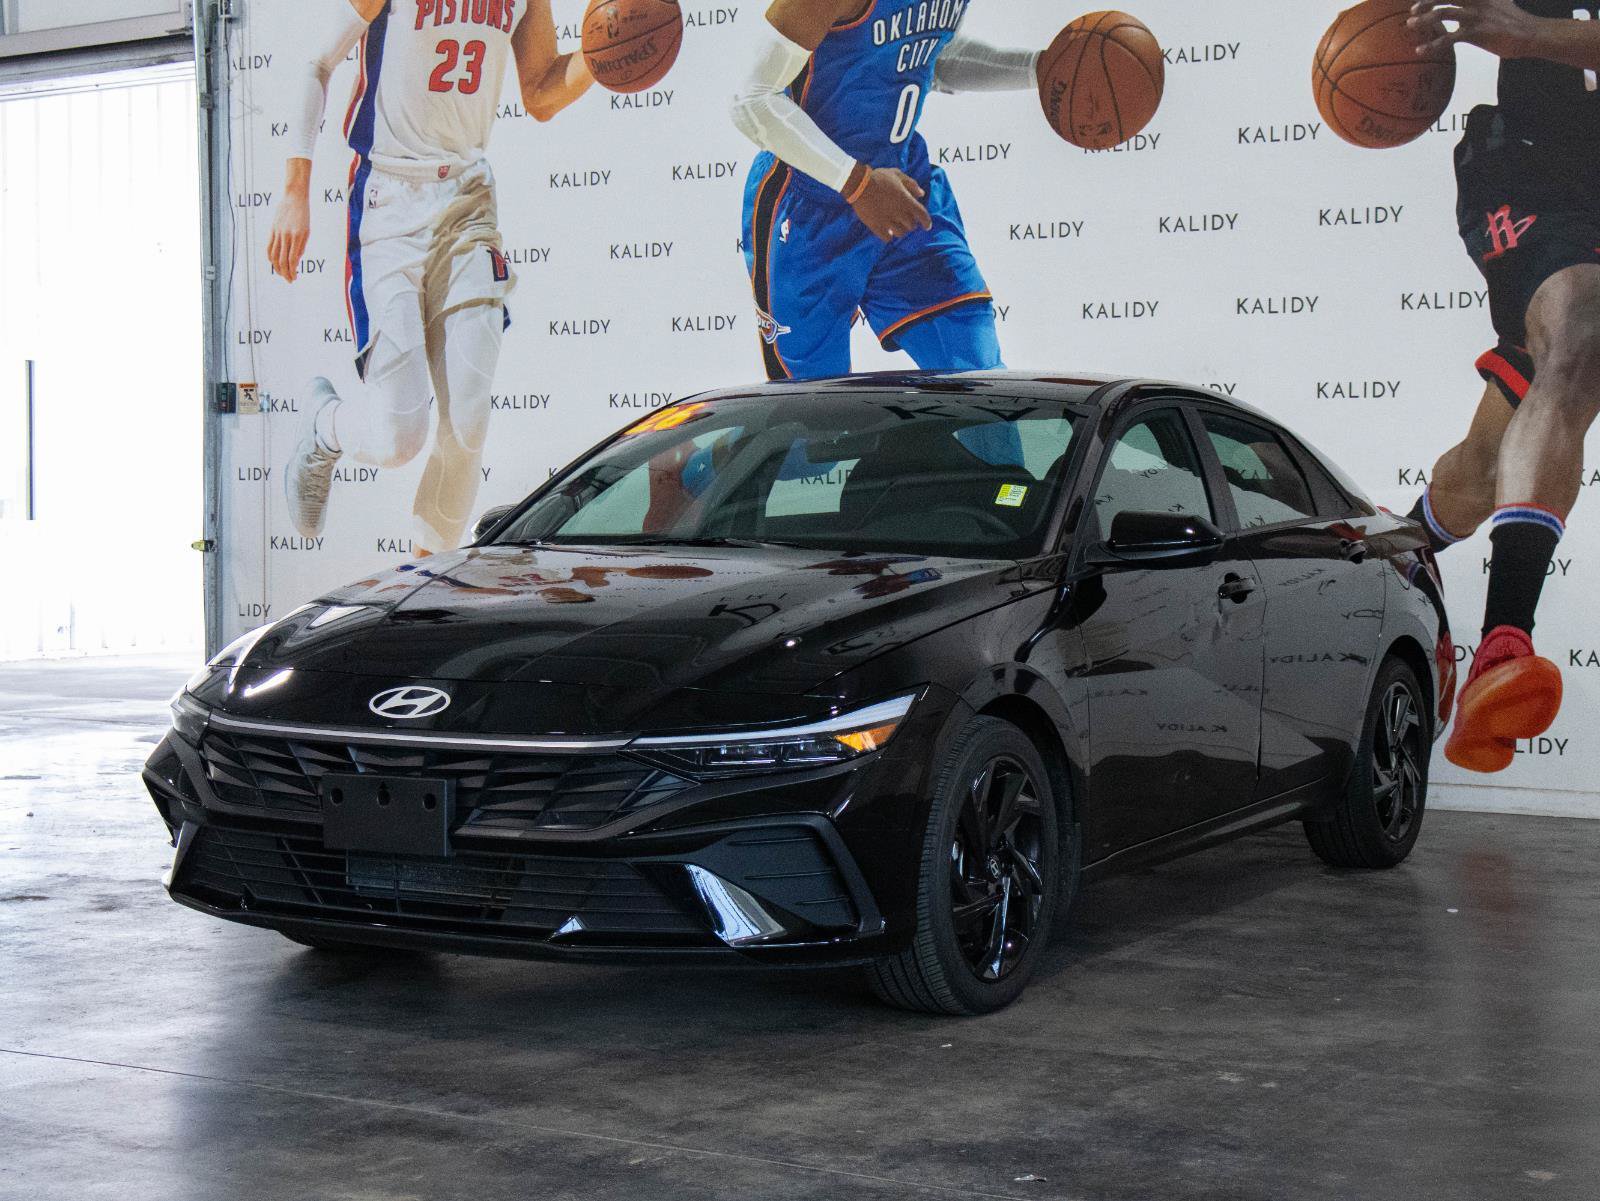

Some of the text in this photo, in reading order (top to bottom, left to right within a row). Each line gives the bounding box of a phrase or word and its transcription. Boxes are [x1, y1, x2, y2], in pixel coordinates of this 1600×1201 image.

[685, 8, 738, 27] ALIDY
[873, 0, 966, 46] OKLAHOM
[232, 54, 272, 71] LIDY
[897, 38, 940, 72] CITY
[1162, 42, 1241, 65] KALIDY
[428, 39, 487, 94] 23
[611, 90, 674, 109] KALIDY
[889, 83, 920, 144] 0
[1238, 123, 1321, 144] KALIDY
[939, 143, 1011, 163] KALIDY
[550, 170, 611, 188] KALIDY
[672, 161, 737, 181] KALIDY
[238, 192, 272, 208] LIDY
[1159, 213, 1238, 233] KALIDY
[1319, 205, 1403, 226] KALIDY
[1010, 221, 1084, 240] KALIDY
[503, 248, 550, 264] ALIDY
[610, 241, 673, 260] KALIDY
[1236, 296, 1319, 315] KALIDY
[1401, 291, 1488, 310] KALIDY
[1082, 301, 1159, 319] KALIDY
[549, 319, 611, 335] KALIDY
[672, 315, 736, 331] KALIDY
[238, 330, 272, 345] LIDY
[324, 328, 352, 342] KAL
[1317, 381, 1400, 399] KALIDY
[271, 398, 298, 413] KAL
[490, 394, 550, 410] KALIDY
[609, 393, 672, 408] KALIDY
[238, 467, 271, 481] LIDY
[333, 468, 378, 482] ALIDY
[270, 536, 324, 550] KALIDY
[377, 538, 412, 553] KALI
[238, 603, 271, 617] LIDY
[1515, 738, 1568, 755] LIDY
